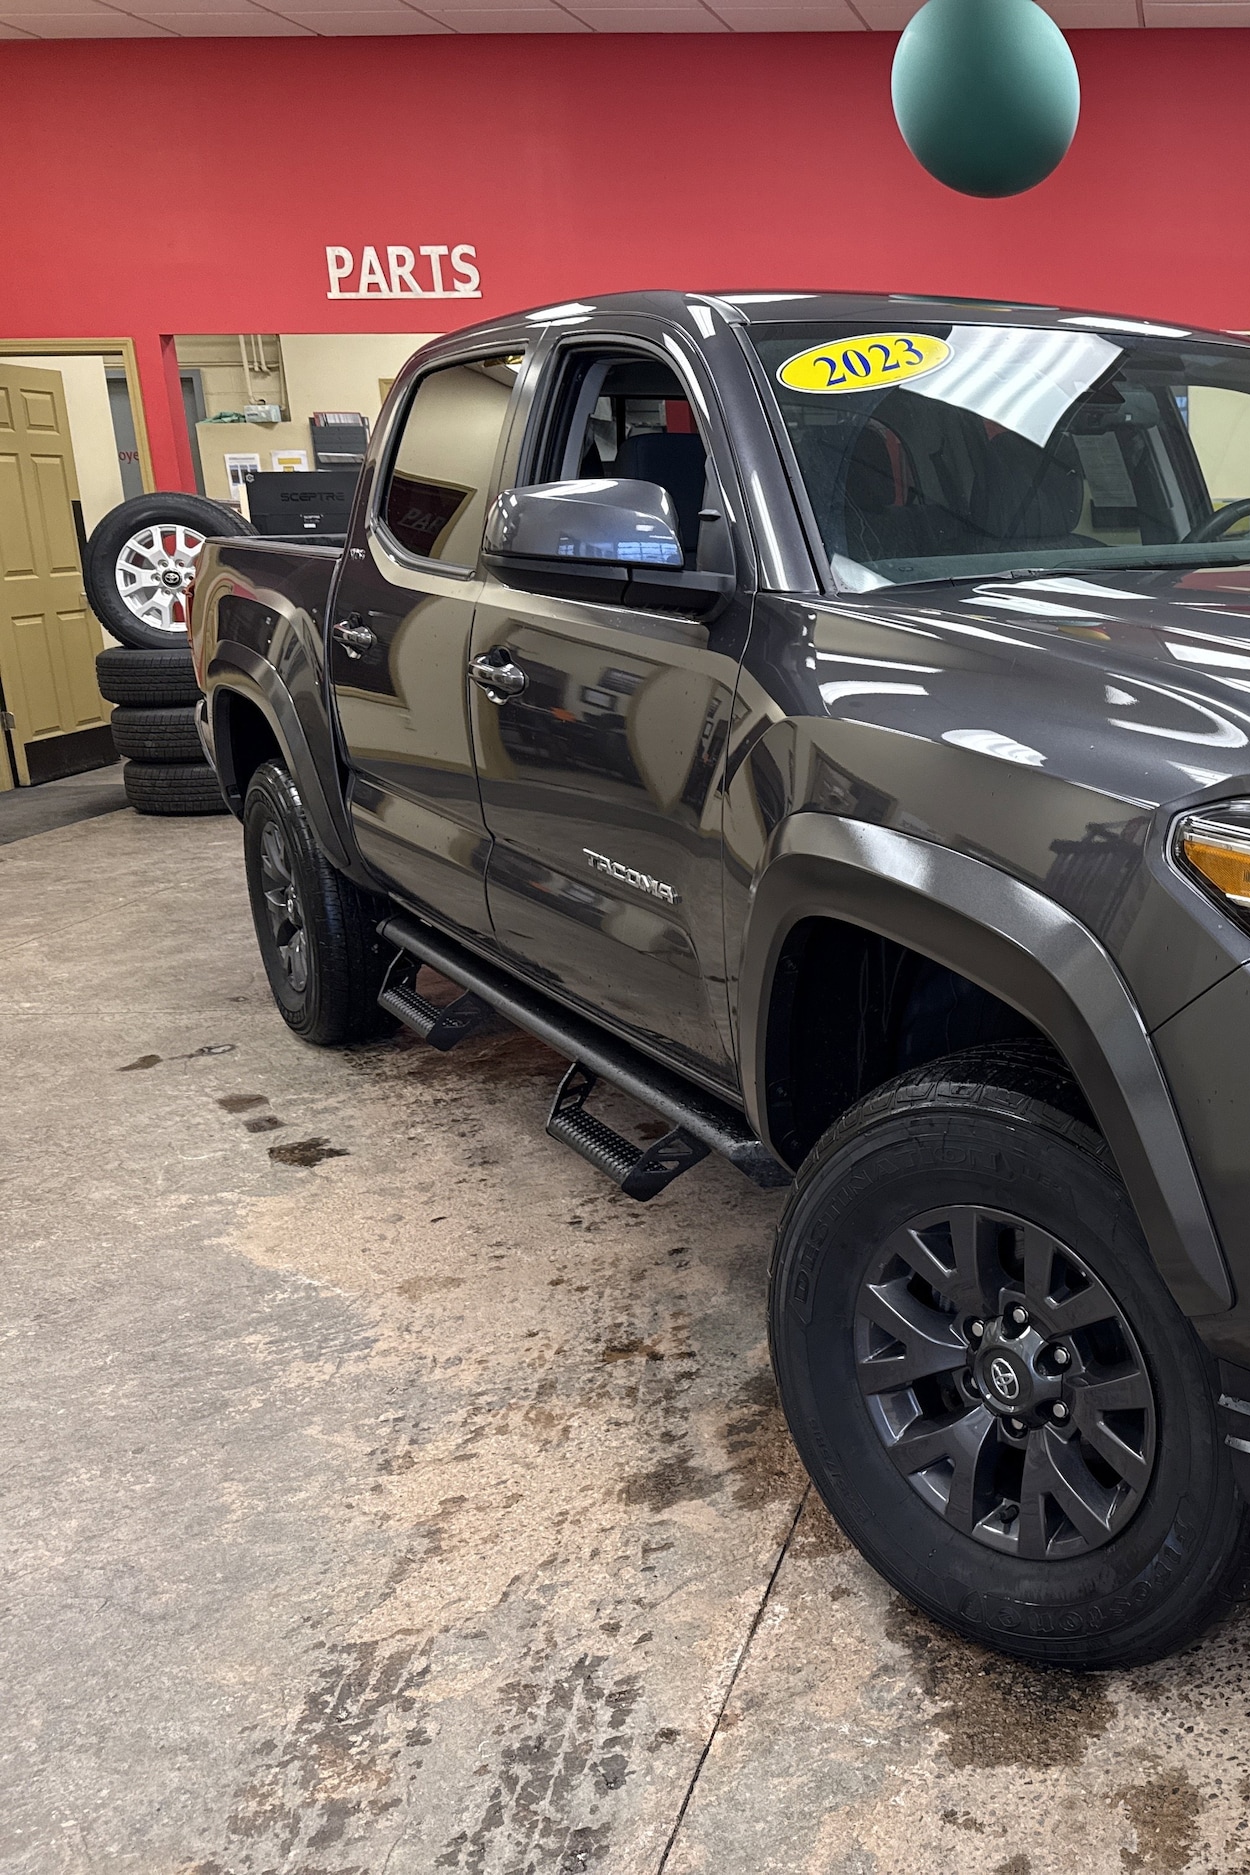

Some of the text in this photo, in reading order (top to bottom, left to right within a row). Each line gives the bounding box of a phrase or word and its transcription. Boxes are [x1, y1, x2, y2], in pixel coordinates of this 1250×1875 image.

[325, 244, 482, 298] PARTS
[813, 338, 924, 387] 2023
[280, 492, 345, 502] SCEPTRE
[583, 847, 674, 904] TACOMA
[793, 1146, 998, 1304] DESTINATION
